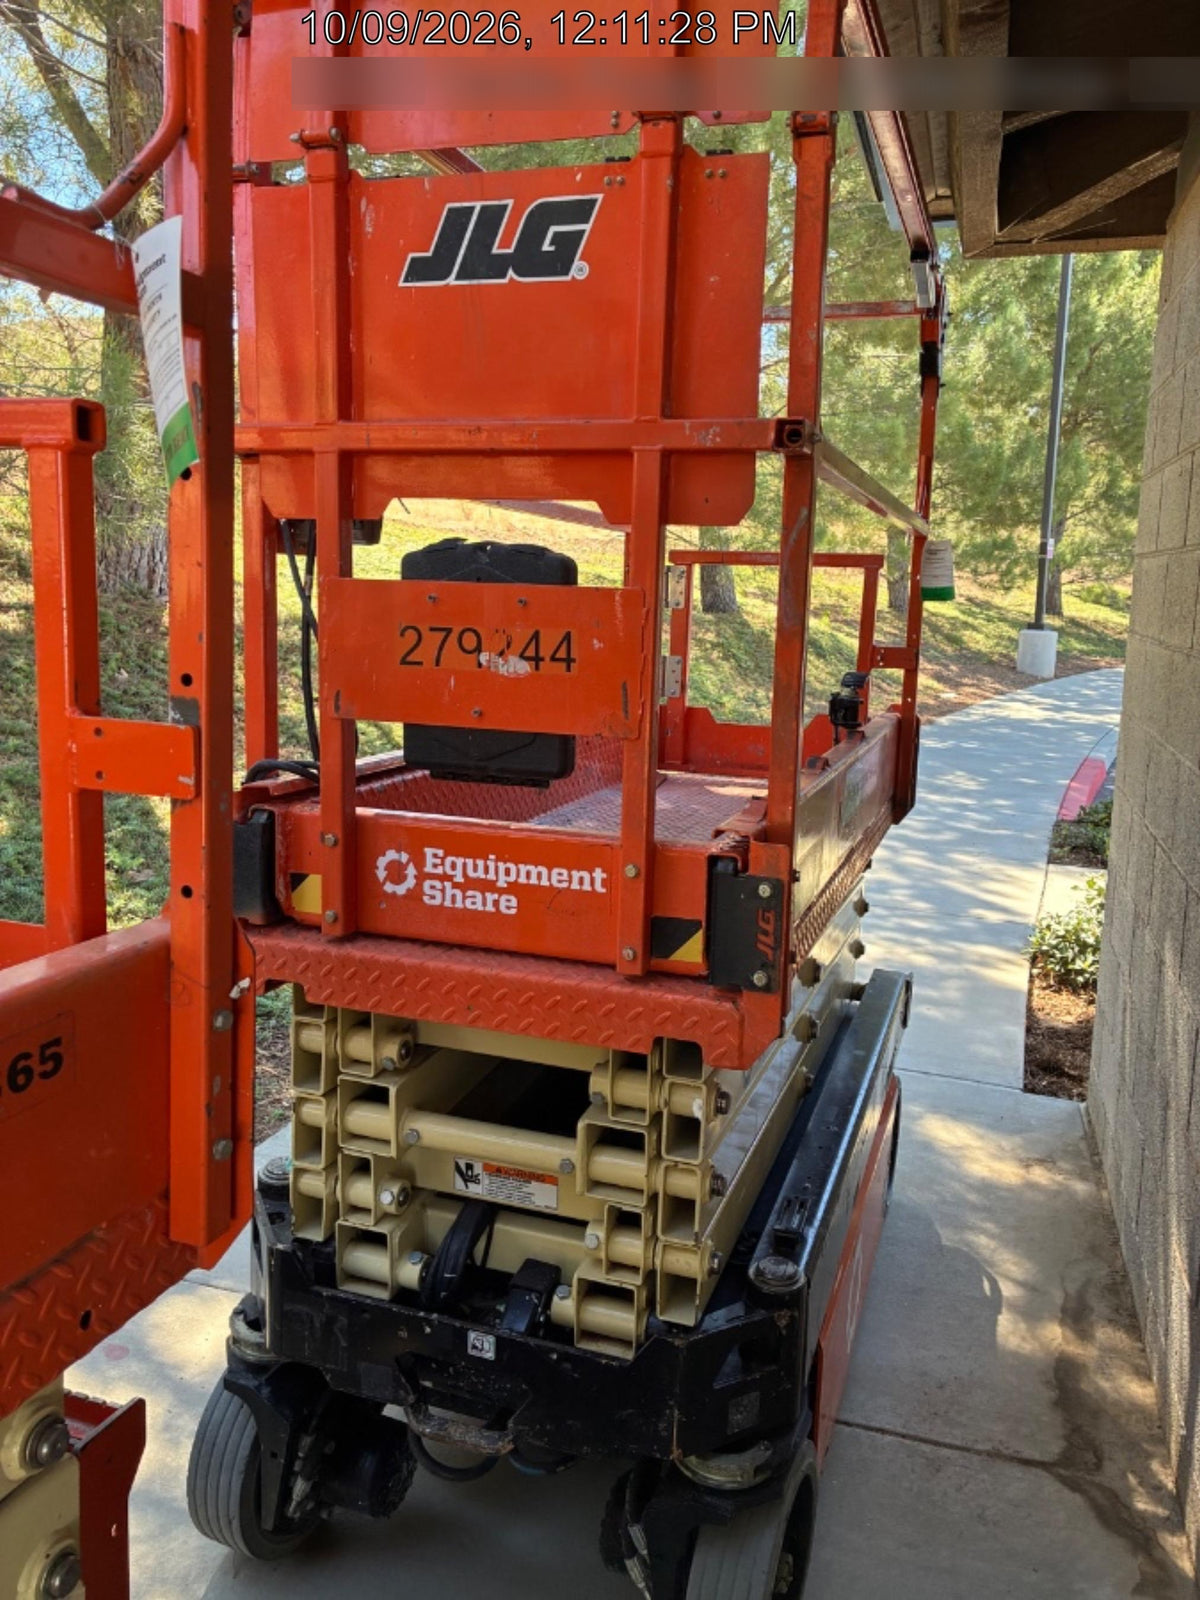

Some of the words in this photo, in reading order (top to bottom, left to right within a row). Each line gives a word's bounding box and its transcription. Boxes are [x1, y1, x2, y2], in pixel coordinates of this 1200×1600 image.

[422, 847, 608, 893] Equipment
[422, 879, 518, 914] Share
[755, 908, 776, 962] JLG
[0, 1036, 64, 1096] 65
